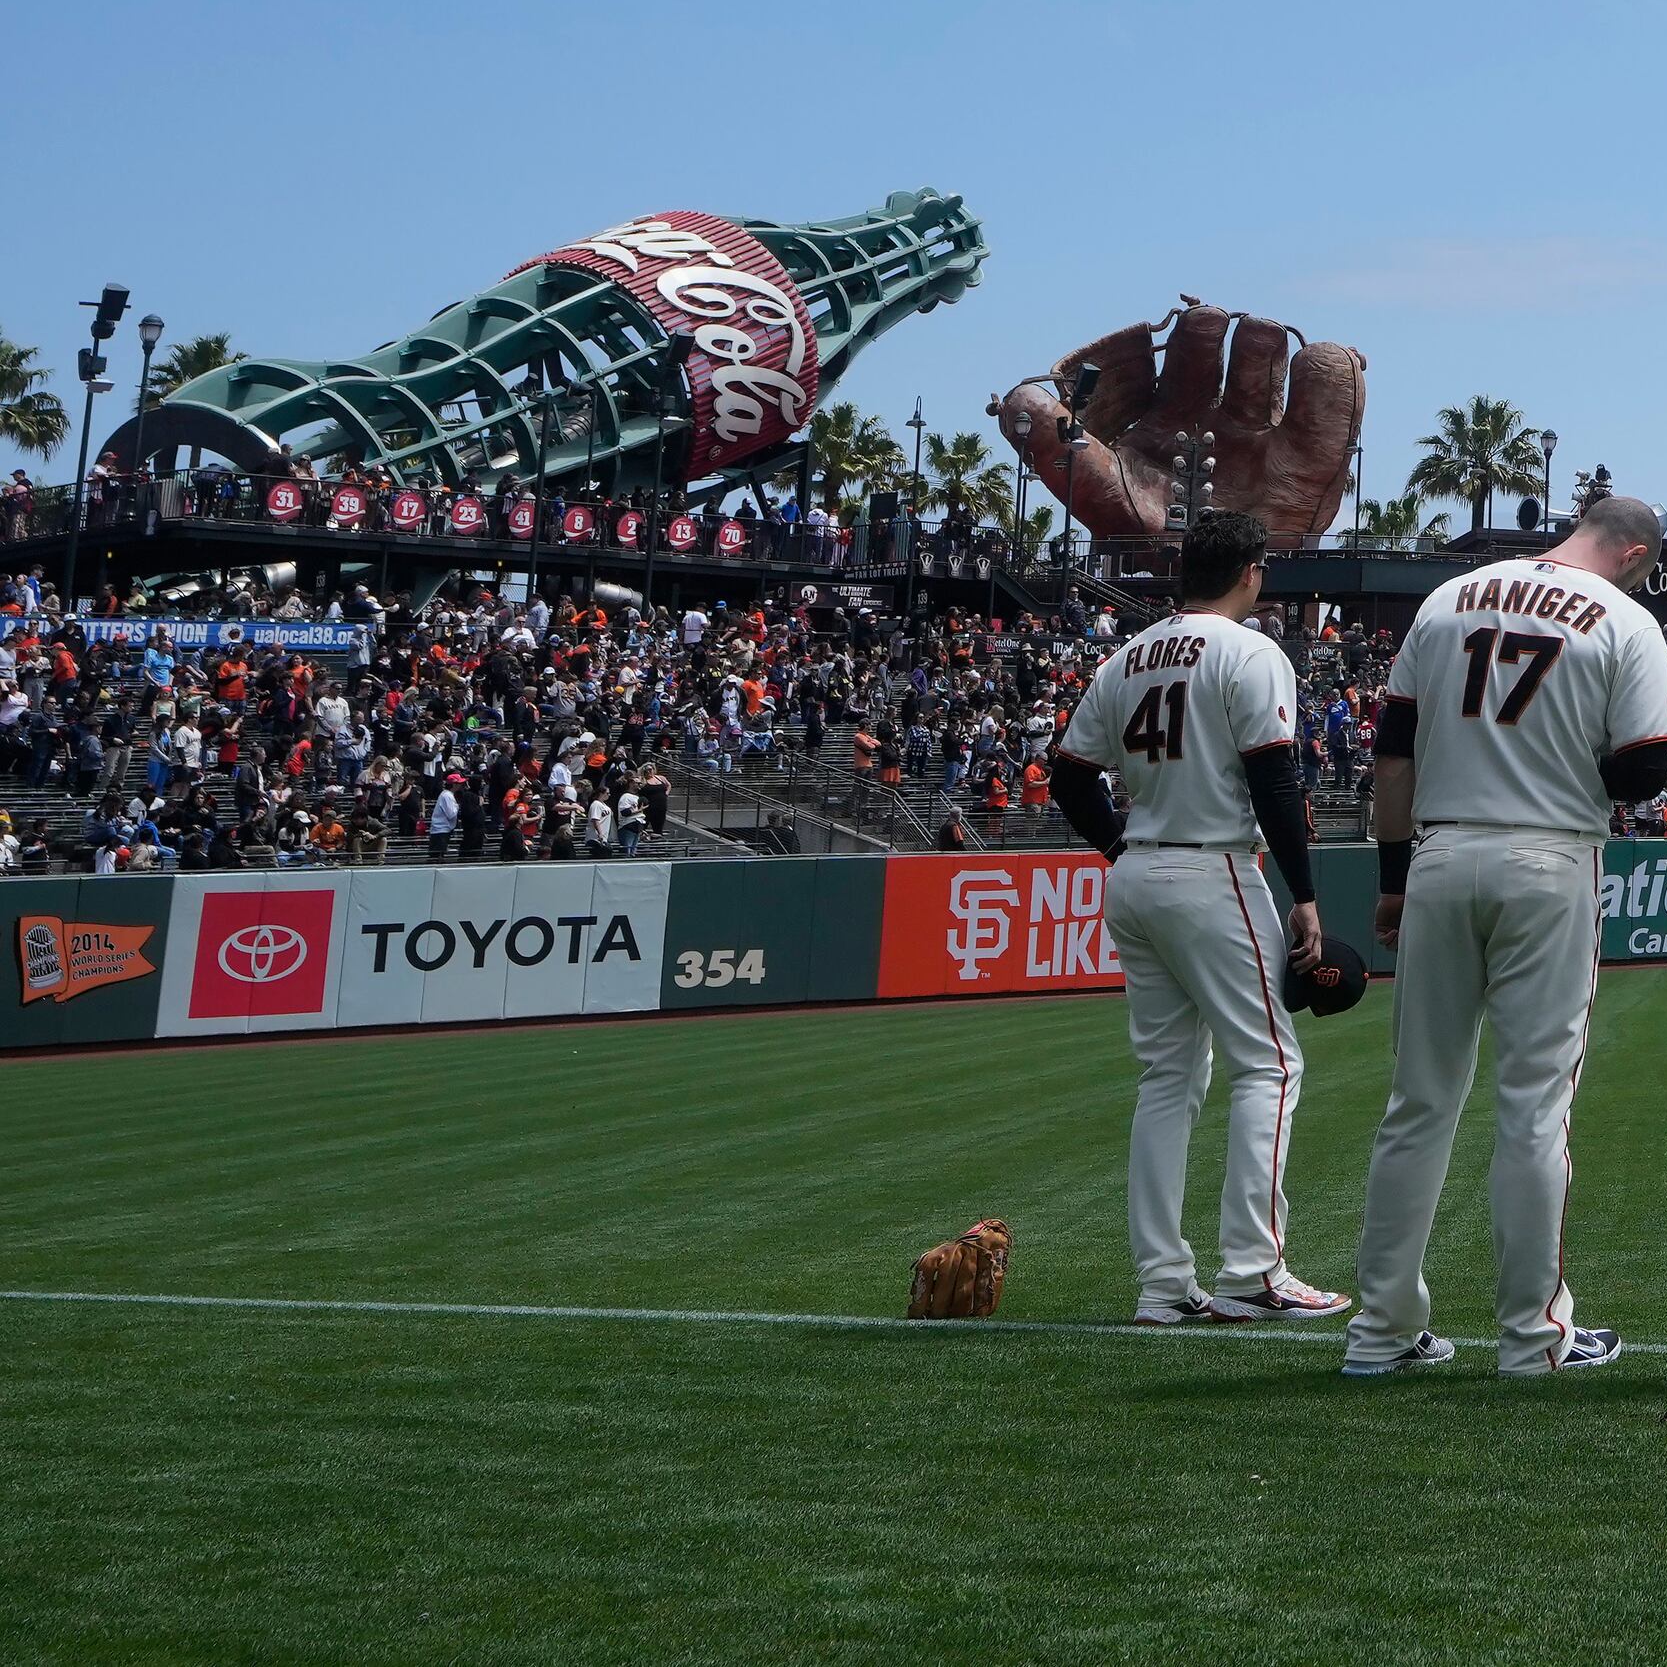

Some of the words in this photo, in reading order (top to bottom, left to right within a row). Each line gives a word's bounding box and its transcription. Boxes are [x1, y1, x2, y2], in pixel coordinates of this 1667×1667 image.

[276, 491, 294, 507] 31
[339, 496, 359, 512] 39
[401, 501, 419, 517] 17
[458, 506, 477, 521] 23
[515, 511, 531, 526] 41
[573, 515, 584, 530] 8
[675, 524, 691, 539] 13
[725, 529, 740, 543] 70
[1456, 579, 1607, 635] HANIGER
[1124, 636, 1206, 679] FLORES
[1462, 627, 1565, 725] 17
[1123, 681, 1187, 764] 41
[1029, 867, 1113, 923] NO
[71, 933, 115, 954] 2014
[361, 914, 642, 973] TOYOTA
[70, 955, 103, 967] WORLD
[105, 950, 136, 963] SERIES
[72, 964, 126, 981] CHAMPIONS
[673, 949, 766, 989] 354
